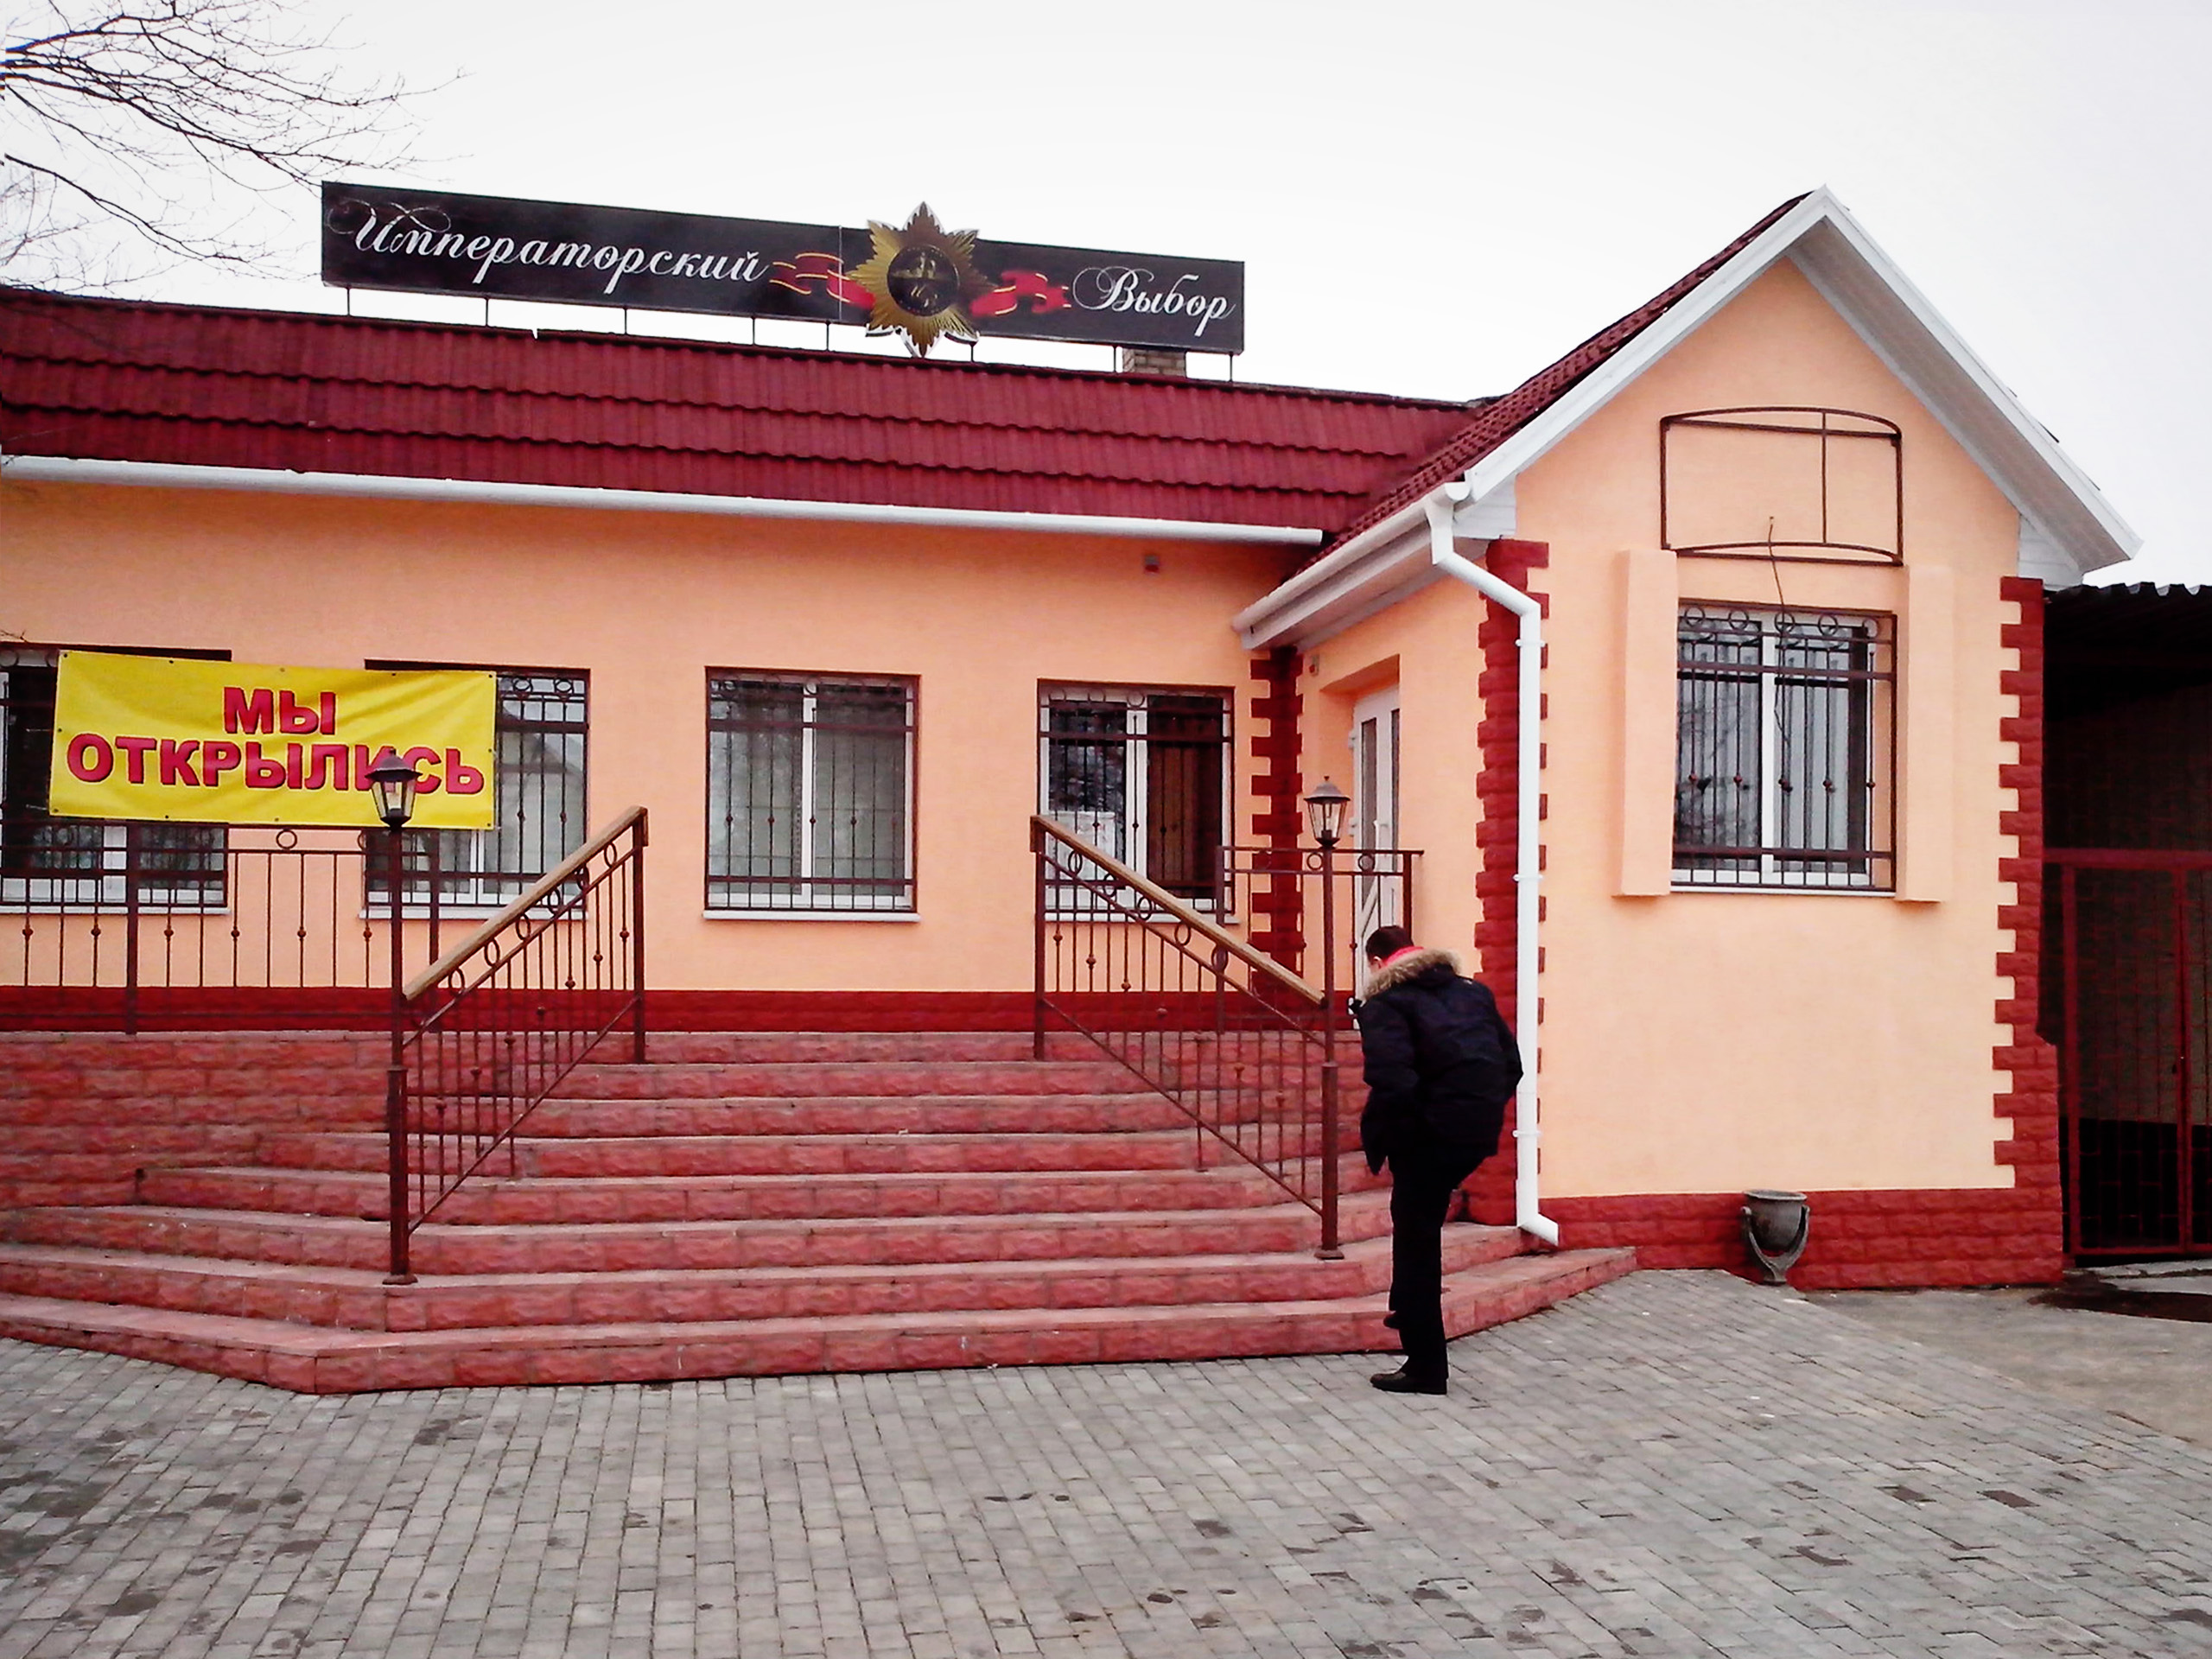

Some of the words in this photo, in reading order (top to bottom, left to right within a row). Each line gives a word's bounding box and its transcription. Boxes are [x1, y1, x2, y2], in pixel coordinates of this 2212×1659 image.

[327, 199, 767, 295] Императорский
[1071, 265, 1236, 337] Выбор
[222, 687, 336, 735] МЫ
